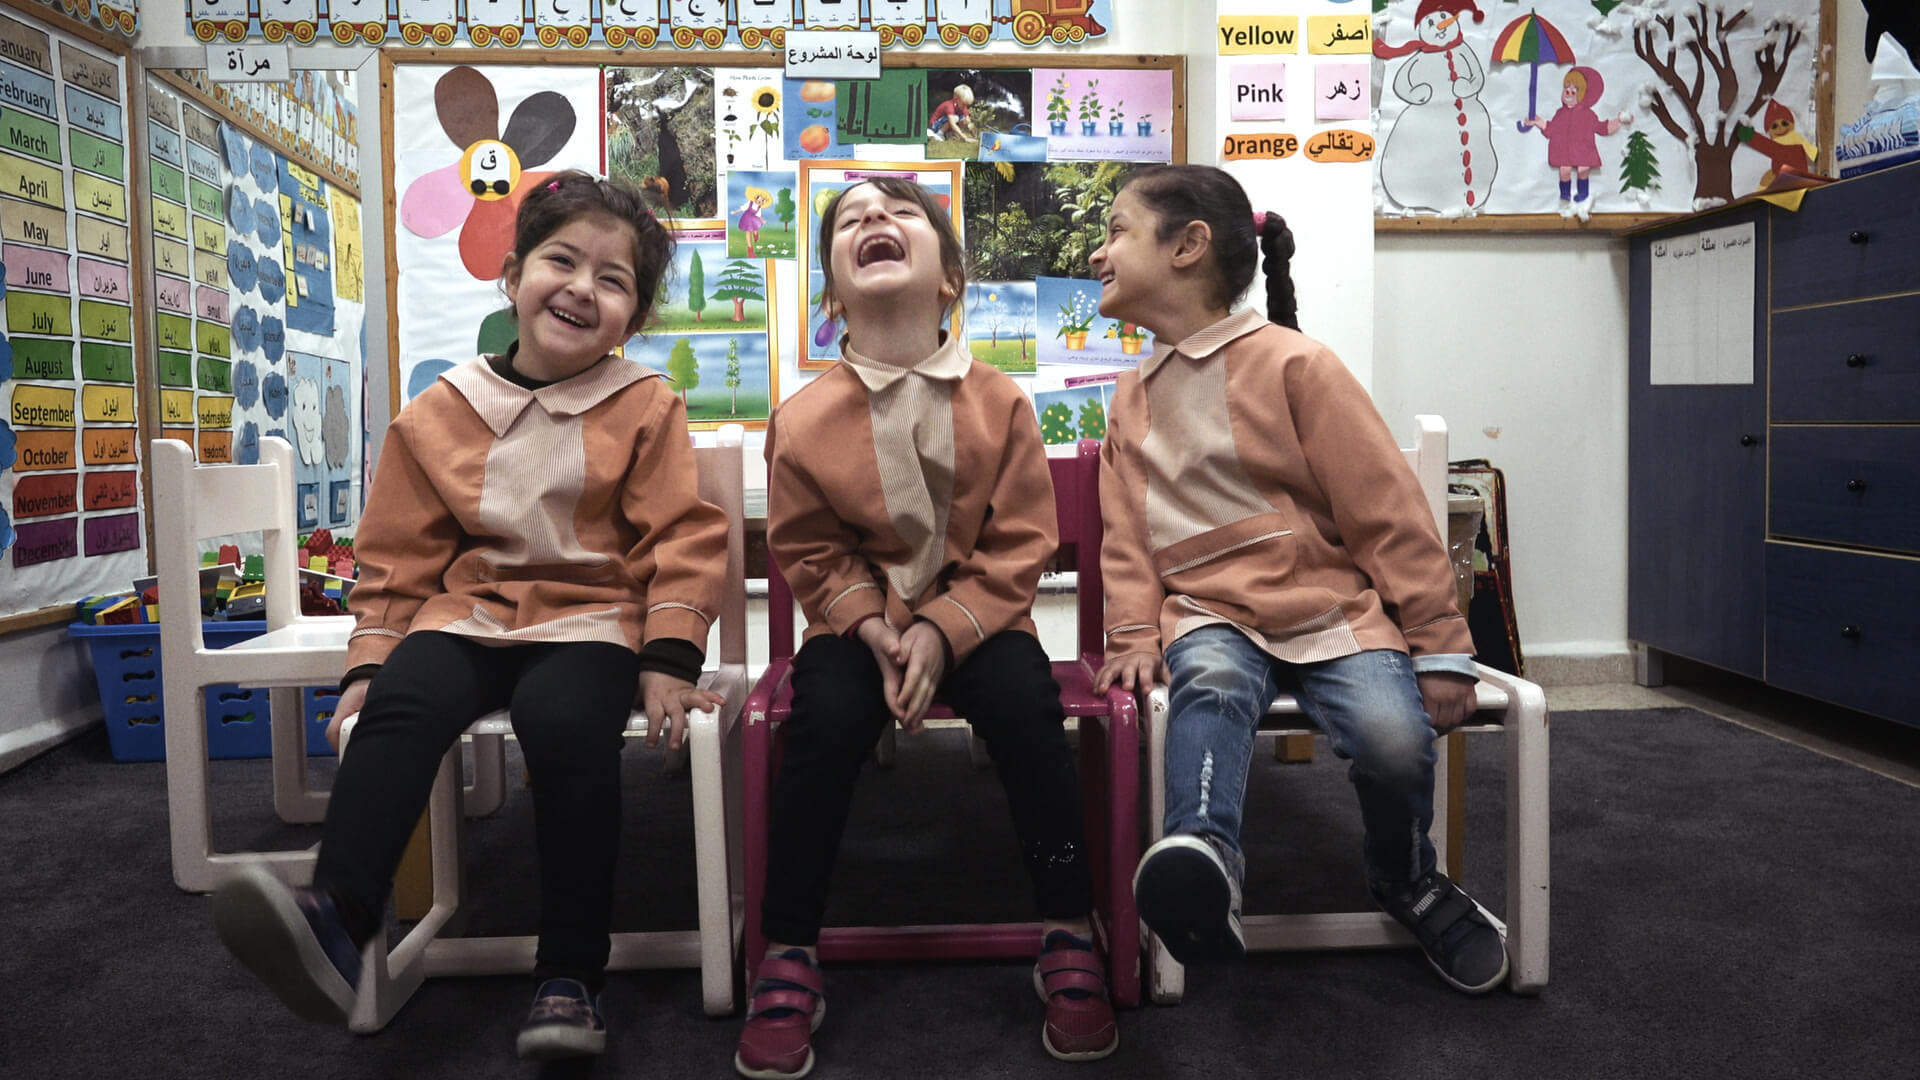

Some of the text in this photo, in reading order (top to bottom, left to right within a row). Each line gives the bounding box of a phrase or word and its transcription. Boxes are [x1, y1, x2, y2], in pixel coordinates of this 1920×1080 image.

[1221, 25, 1294, 45] Yellow
[1323, 20, 1369, 47] أصفر
[0, 39, 42, 69] anuary
[228, 48, 270, 75] مرآة
[788, 46, 878, 65] لوحة المشروع
[1237, 83, 1283, 103] Pink
[1326, 80, 1360, 100] زهر
[86, 105, 105, 128] شباط
[10, 127, 48, 154] March
[1224, 136, 1297, 156] Orange
[1309, 132, 1372, 157] برتقالي
[480, 149, 496, 170] ق
[19, 175, 48, 199] April
[92, 192, 112, 210] نيسان
[23, 221, 48, 247] May
[26, 267, 52, 286] June
[94, 275, 118, 293] حزيران
[32, 312, 53, 333] July
[101, 319, 117, 336] تموز
[25, 356, 63, 377] August
[14, 402, 74, 425] September
[23, 448, 68, 466] October
[108, 440, 128, 458] تشرين
[17, 489, 74, 513] November
[17, 536, 74, 562] December
